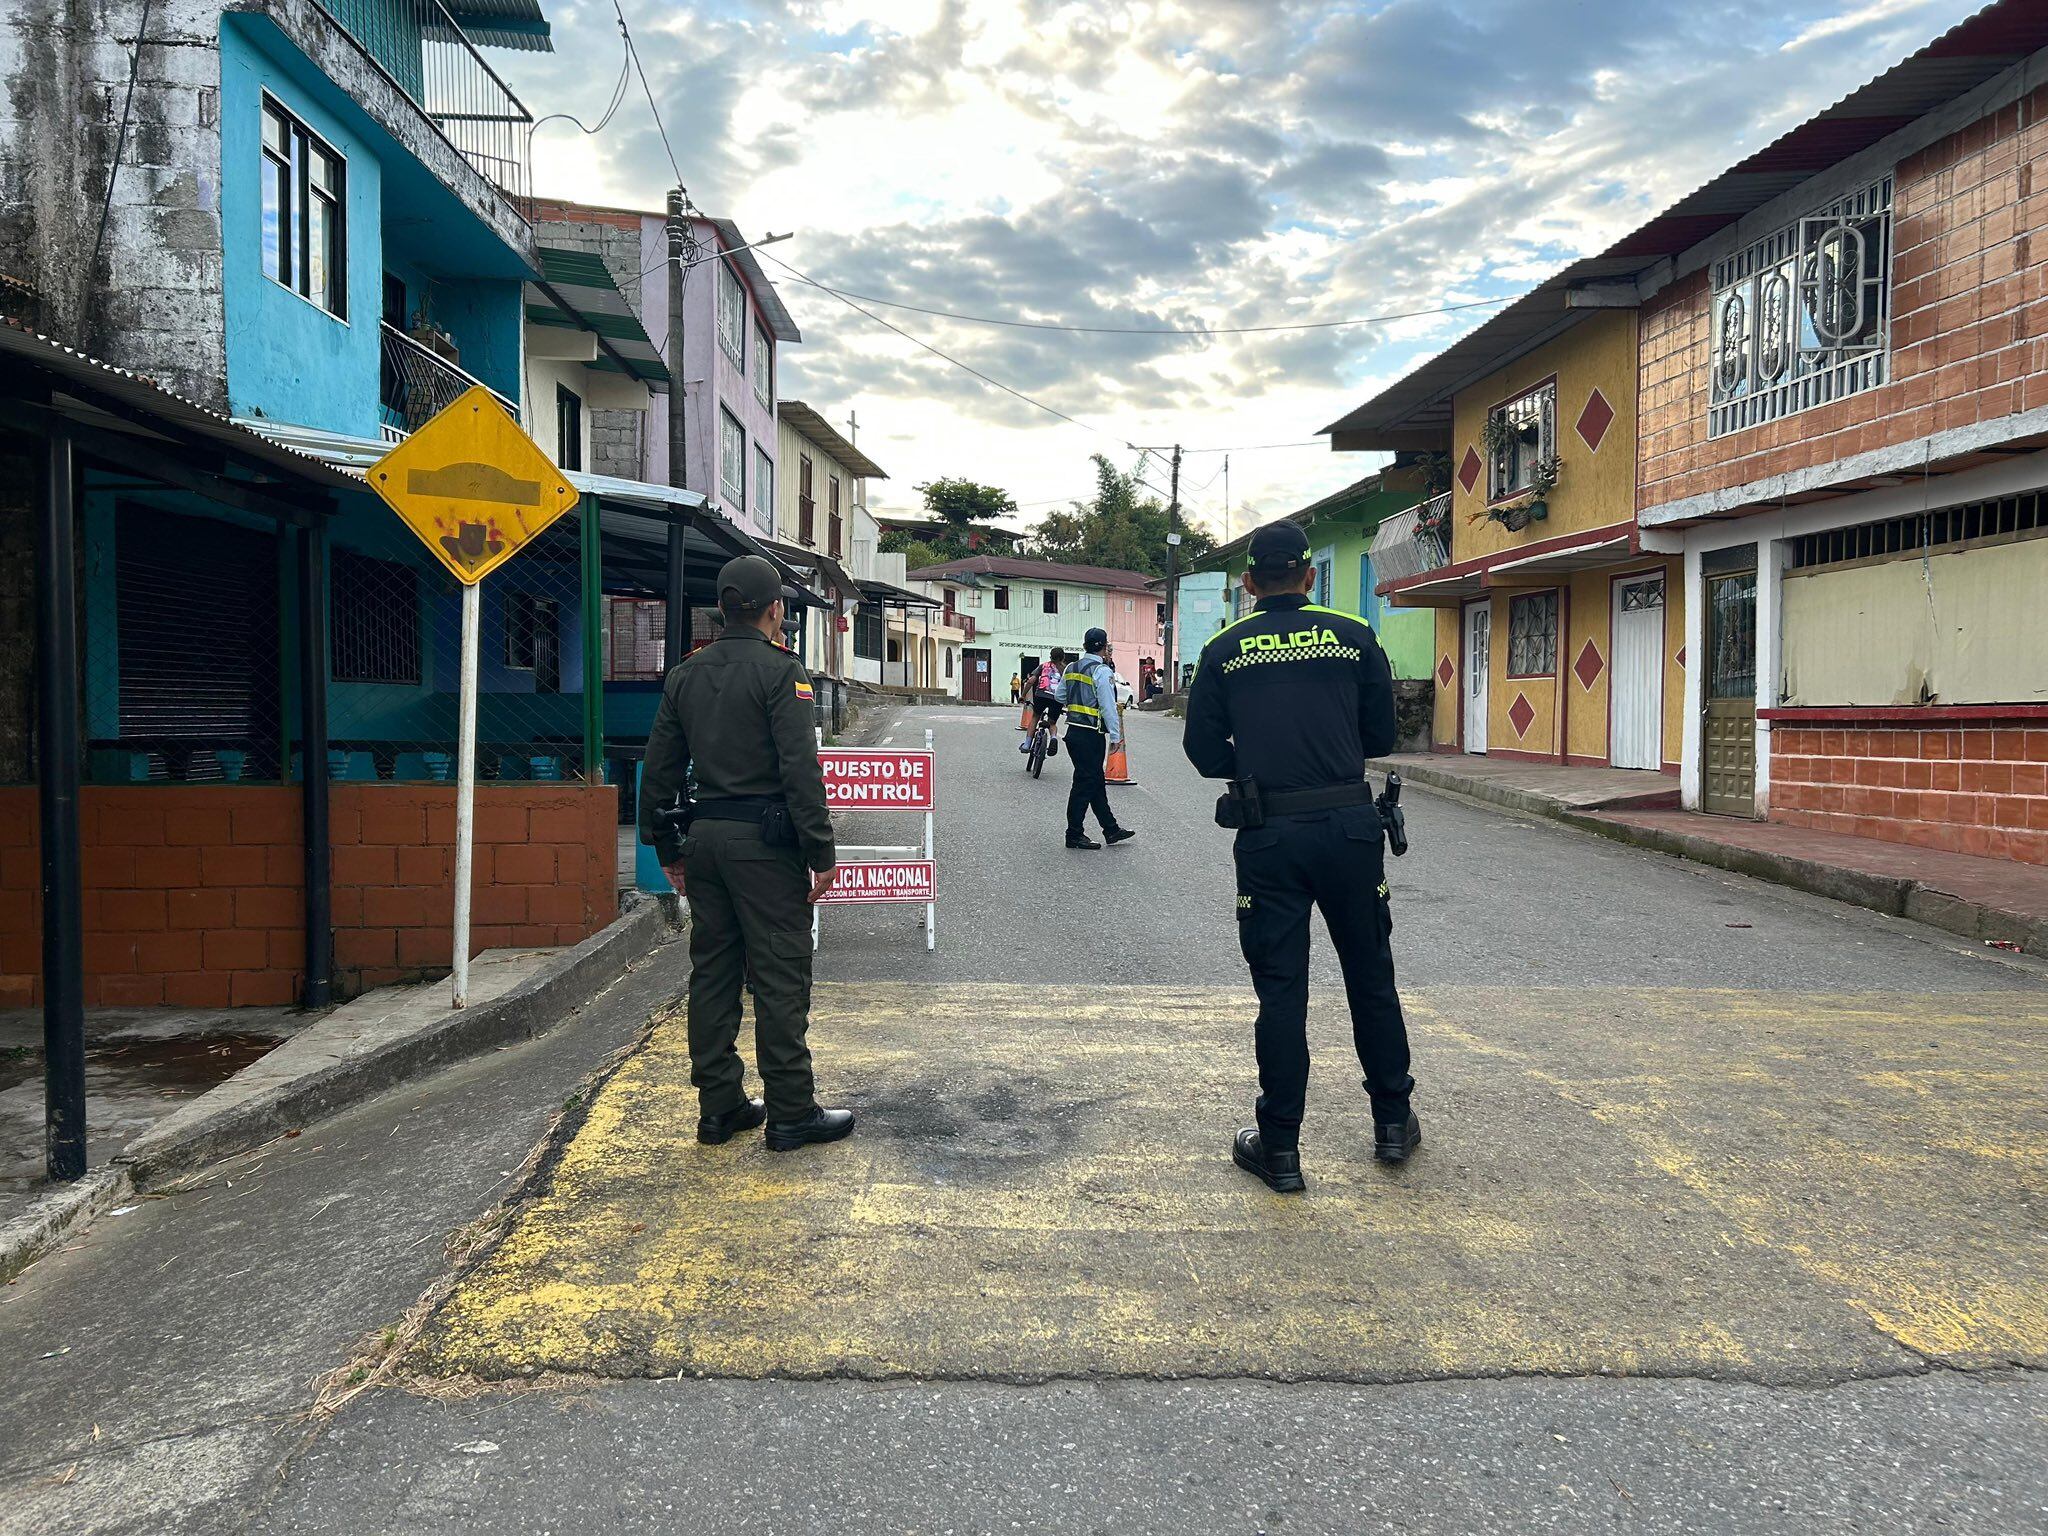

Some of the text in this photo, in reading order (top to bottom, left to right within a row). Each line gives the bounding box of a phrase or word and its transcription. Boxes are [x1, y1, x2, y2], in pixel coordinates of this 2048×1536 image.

[1240, 625, 1340, 654] POLICÍA
[823, 760, 925, 779] PUESTO DE
[825, 783, 925, 800] CONTROL
[832, 866, 930, 889] LICÍA NACIONAL
[822, 889, 848, 898] ECCIÓN
[893, 888, 930, 896] TRANSPORTE
